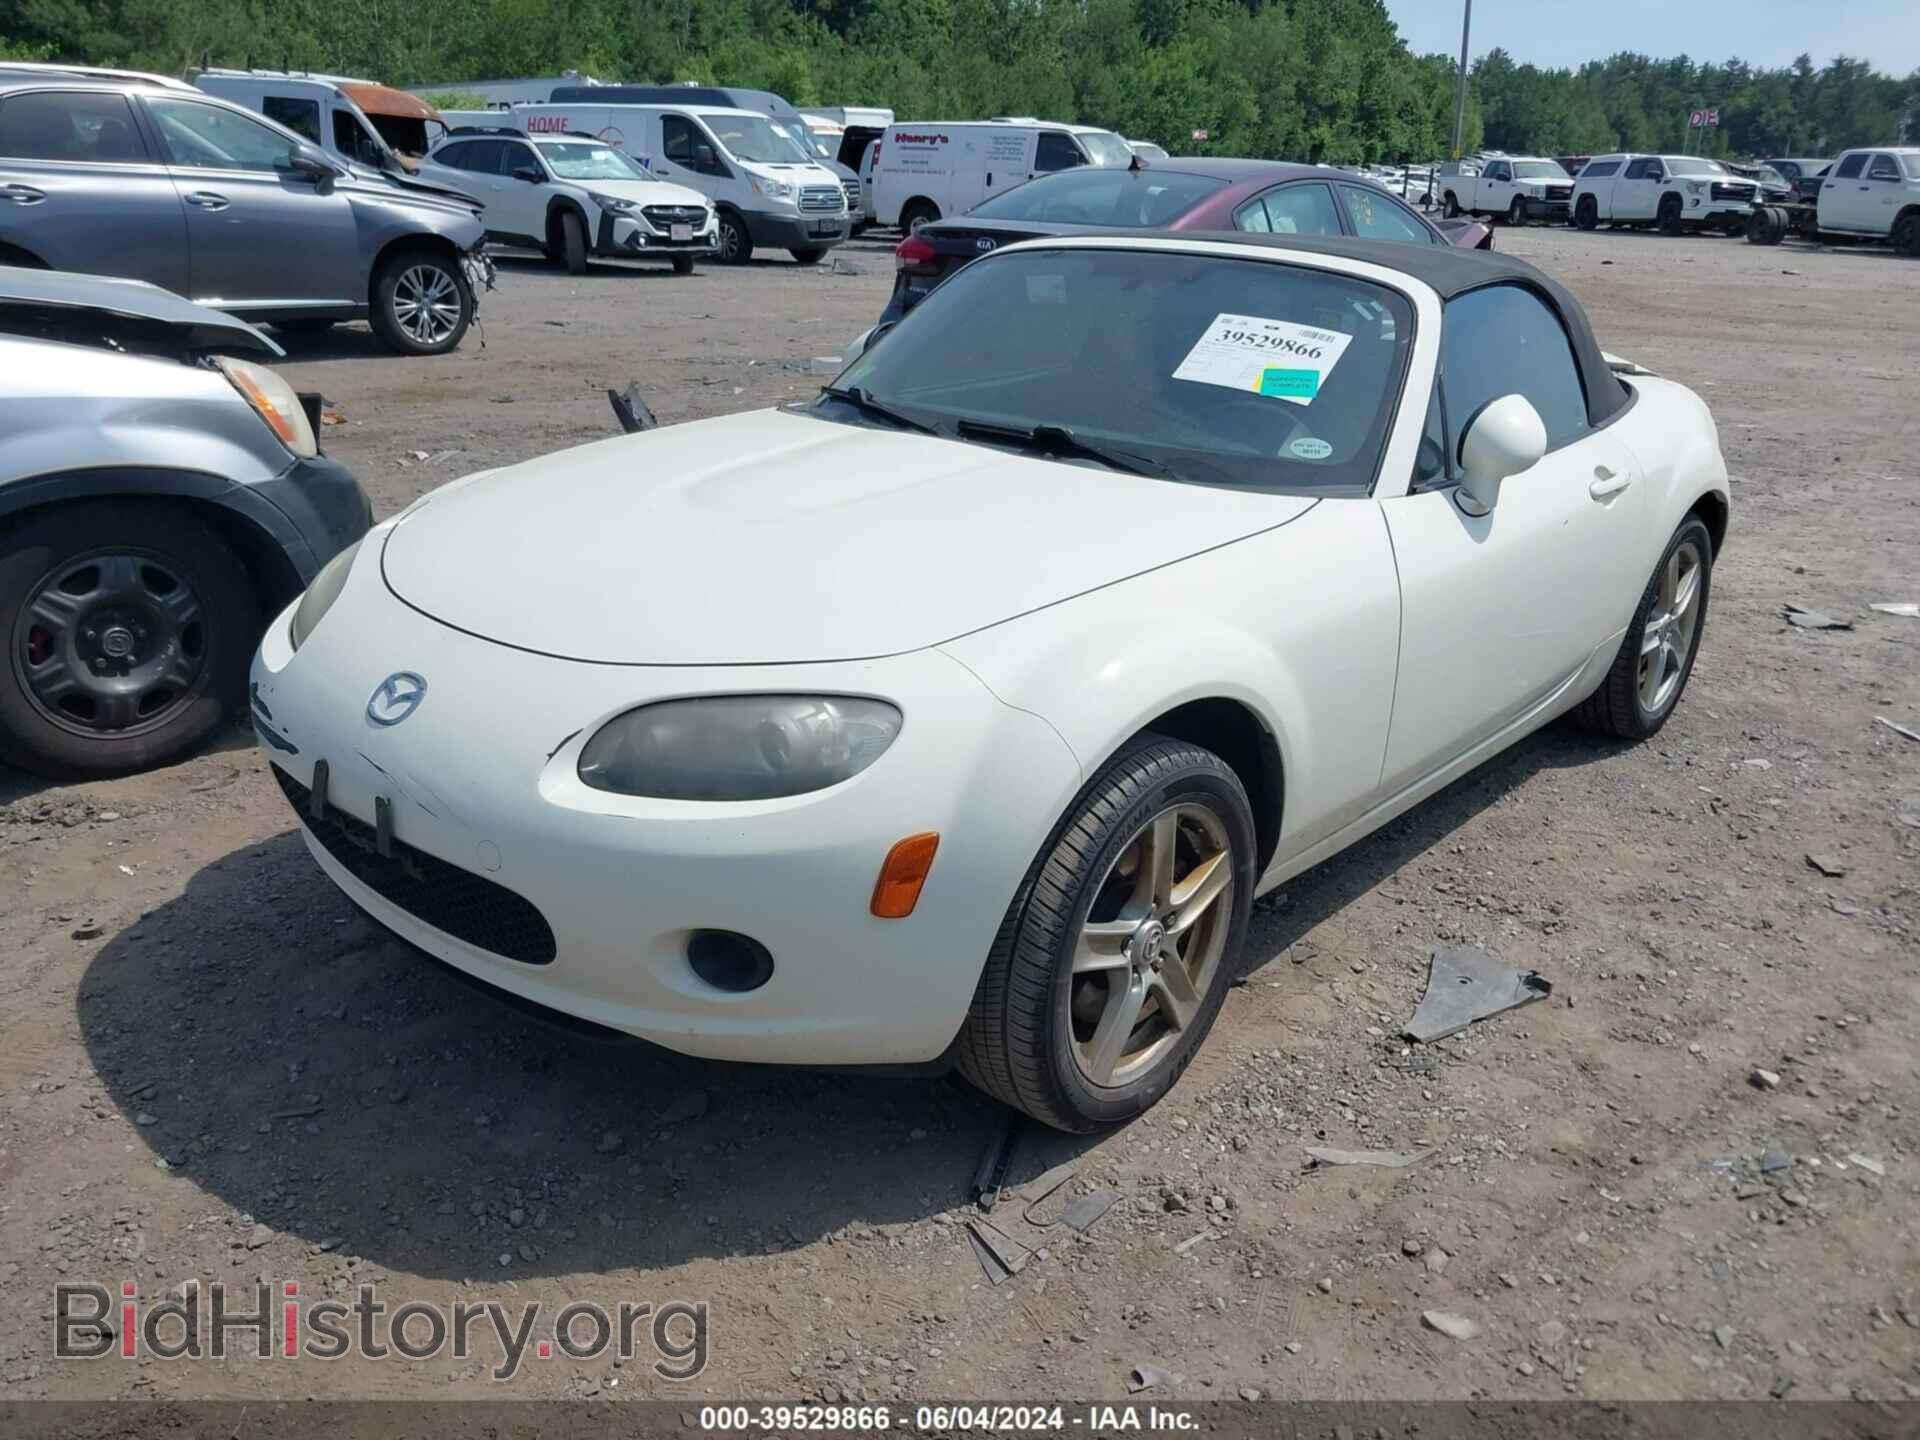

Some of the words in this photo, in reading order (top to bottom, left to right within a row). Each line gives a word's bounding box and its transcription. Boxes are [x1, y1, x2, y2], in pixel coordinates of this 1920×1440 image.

[527, 117, 568, 133] HOME
[895, 133, 949, 145] Henry's
[1215, 329, 1323, 360] 39529866
